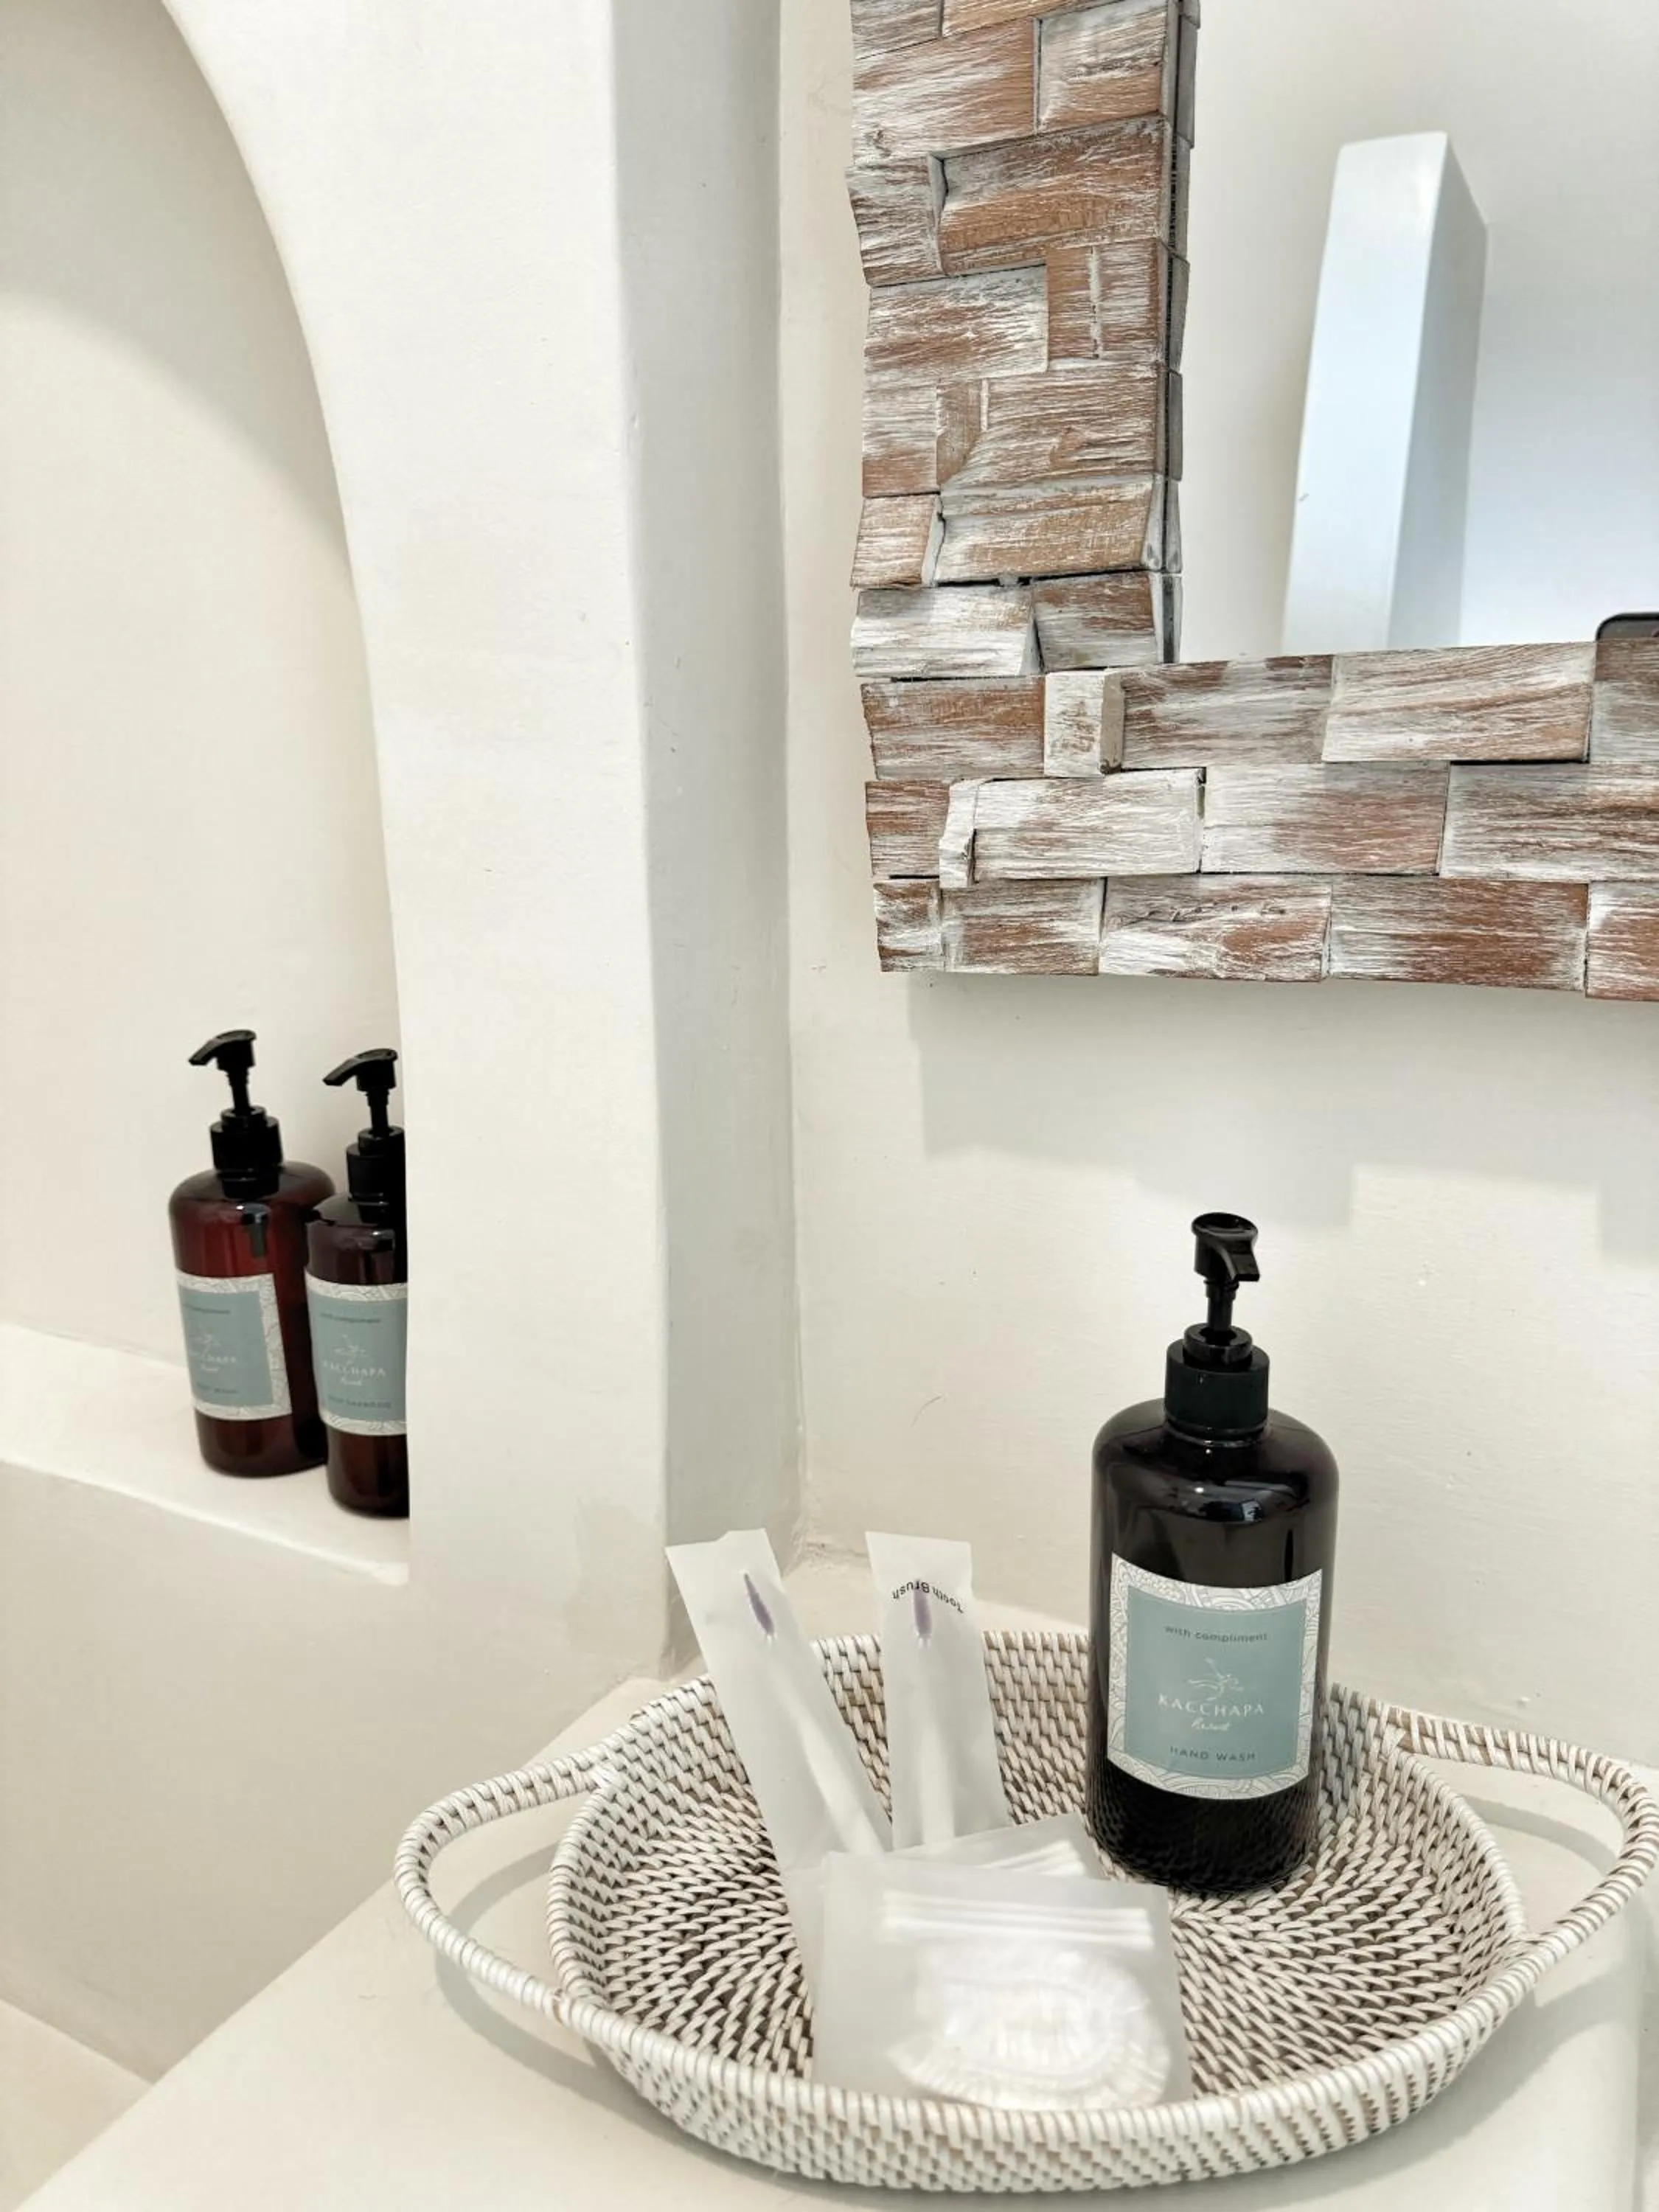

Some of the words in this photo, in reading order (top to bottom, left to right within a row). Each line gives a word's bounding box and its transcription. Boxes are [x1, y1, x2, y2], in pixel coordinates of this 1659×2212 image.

[892, 1580, 930, 1599] Brush
[933, 1586, 963, 1613] Tooth
[1165, 1626, 1191, 1638] with
[1194, 1631, 1267, 1644] compliment
[1170, 1745, 1209, 1760] HAND
[1217, 1752, 1256, 1761] WASH
